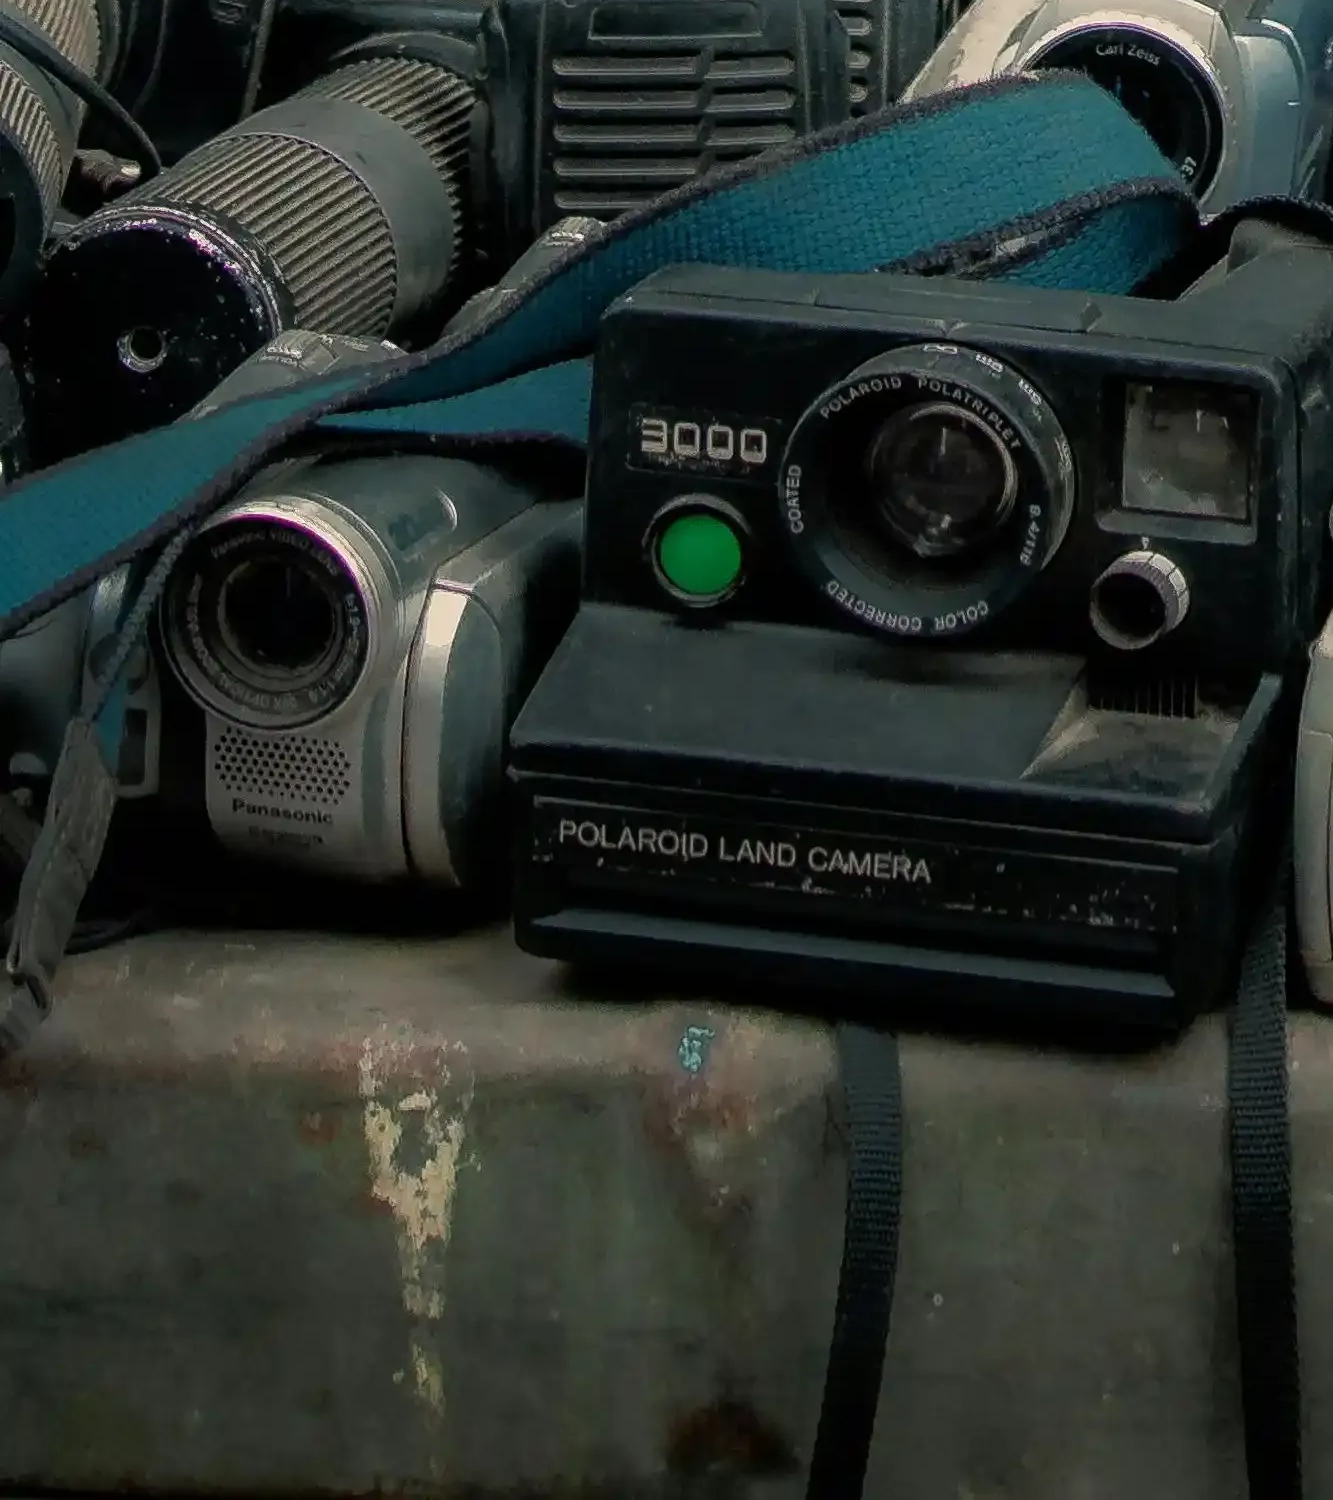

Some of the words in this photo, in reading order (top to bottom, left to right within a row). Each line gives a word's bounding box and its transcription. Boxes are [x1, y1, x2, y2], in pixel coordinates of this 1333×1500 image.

[1094, 41, 1125, 57] Carl
[1127, 43, 1161, 67] Zeiss
[819, 376, 903, 420] POLAROID
[917, 377, 1022, 450] POLATRIPLET
[639, 416, 768, 463] 3000
[785, 463, 804, 535] COATED
[825, 579, 923, 632] CORRECTED
[933, 600, 991, 632] COLOR
[231, 798, 333, 826] Panasonic
[557, 818, 709, 863] POLAROID
[718, 834, 798, 870] LAND
[807, 846, 932, 885] CAMERA
